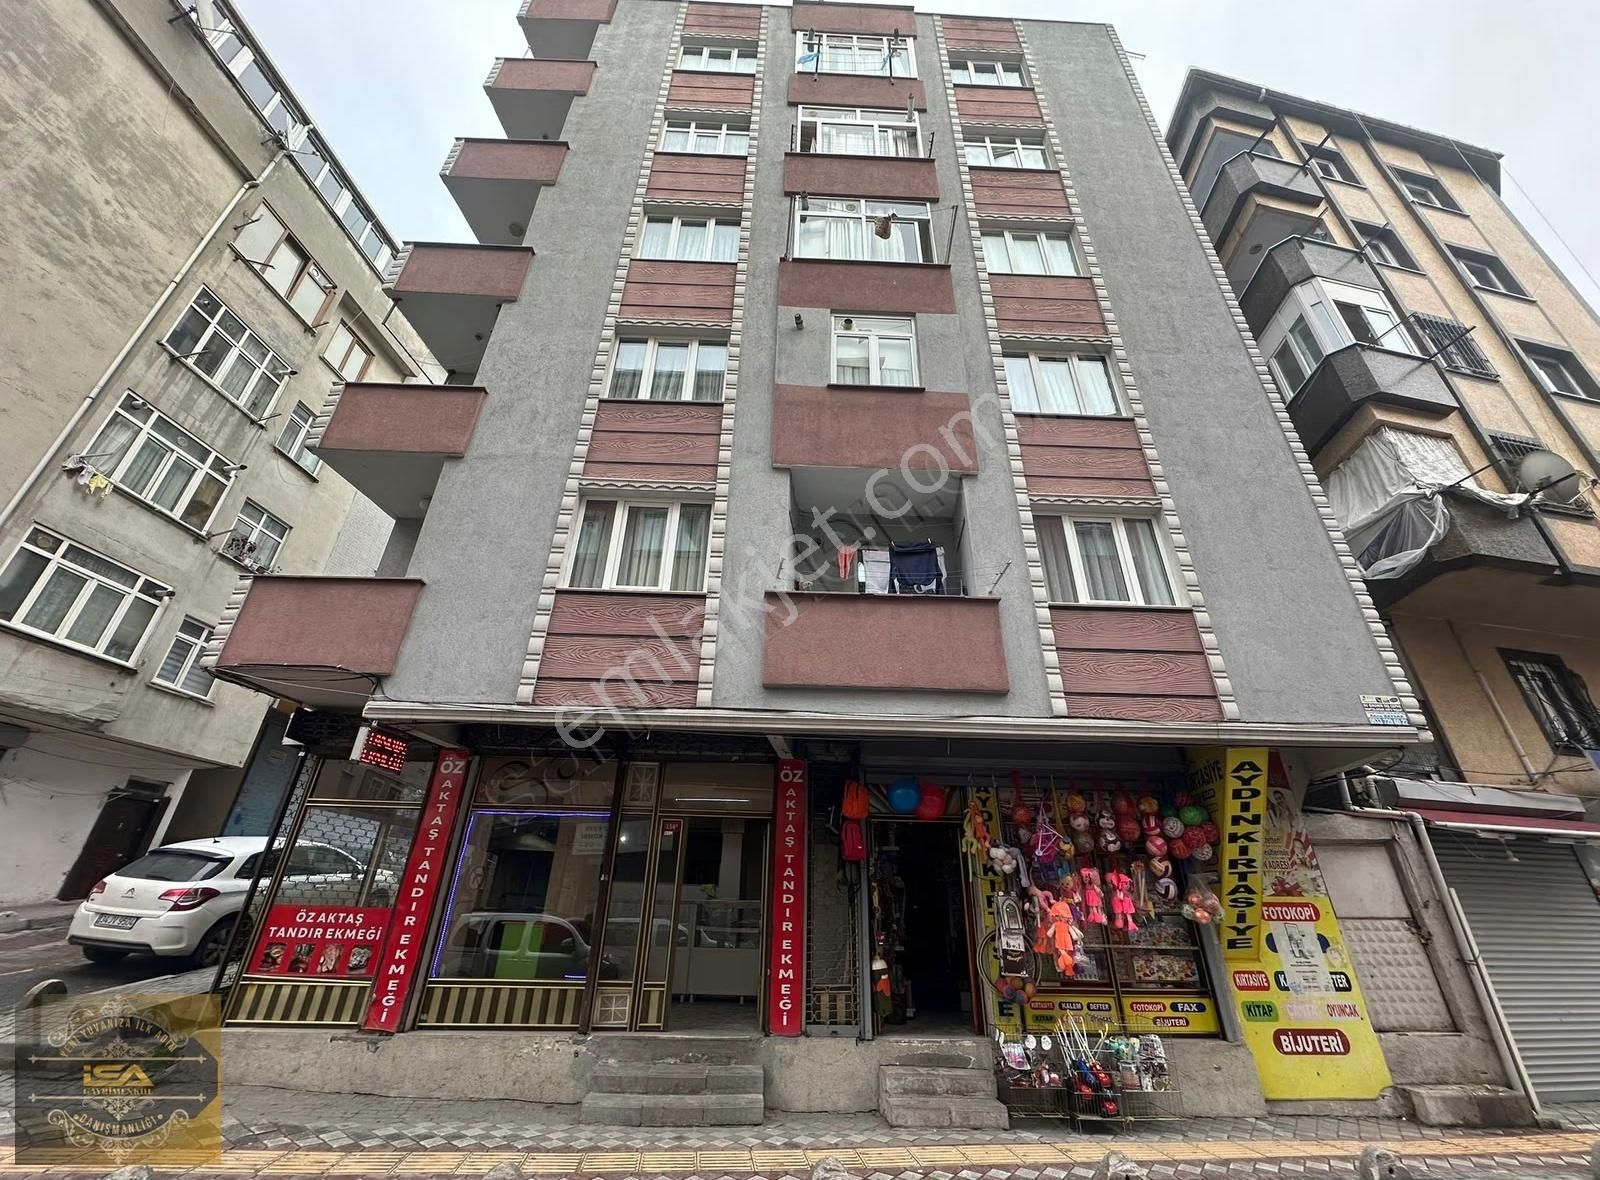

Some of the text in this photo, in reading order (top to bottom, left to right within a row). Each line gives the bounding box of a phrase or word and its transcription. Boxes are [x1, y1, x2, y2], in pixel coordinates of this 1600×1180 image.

[1225, 761, 1264, 950] AYDIN KIRTASİYE
[380, 757, 465, 1023] ÖZ AKTAŞ TANDIR EKMEĞİ
[778, 766, 803, 1026] ÖZ AKTAŞ TANDIR EKMEĞİ
[296, 909, 364, 927] ÖZ AKTAŞ
[1262, 904, 1316, 921] FOTOKOPİ
[269, 926, 383, 941] TANDIR EKMEĞİ
[1234, 972, 1269, 987] KIRTASİYE
[1178, 1003, 1199, 1012] FAX
[1246, 1002, 1273, 1017] KİTAP
[1280, 1032, 1345, 1053] BİJUTERİ
